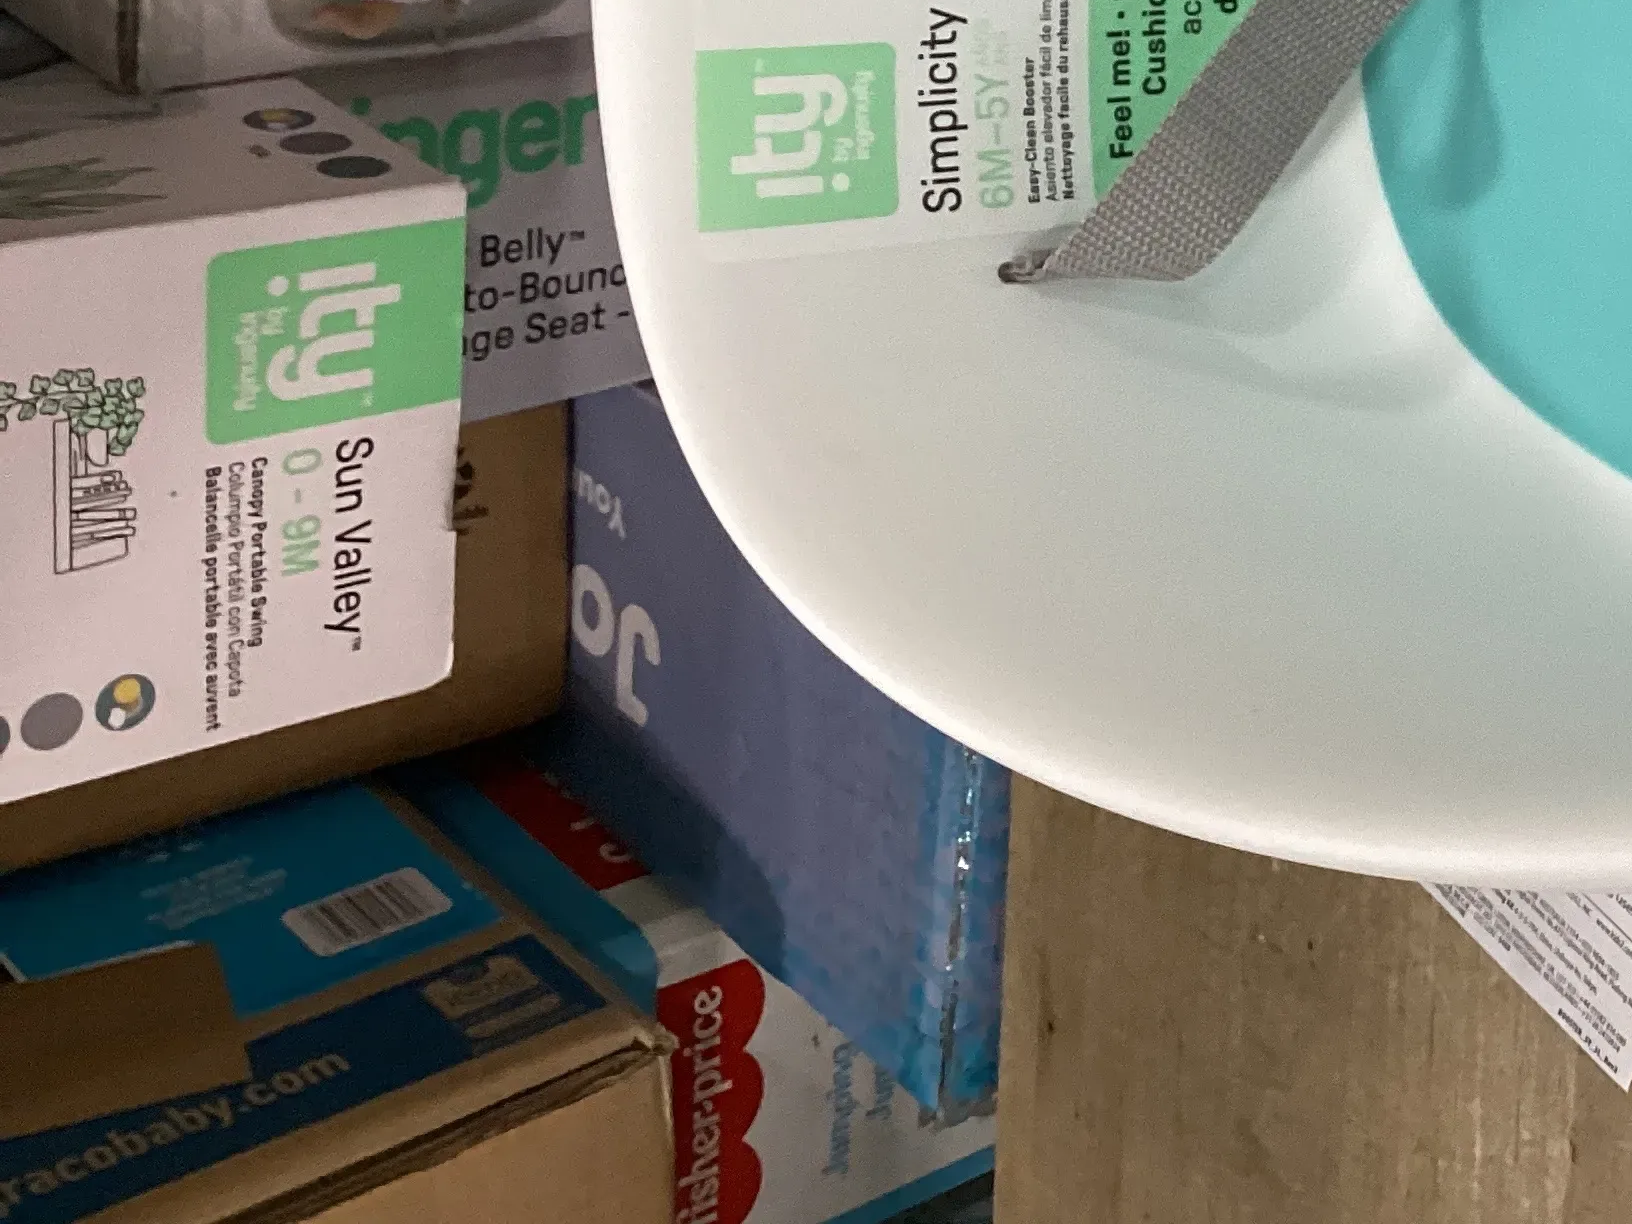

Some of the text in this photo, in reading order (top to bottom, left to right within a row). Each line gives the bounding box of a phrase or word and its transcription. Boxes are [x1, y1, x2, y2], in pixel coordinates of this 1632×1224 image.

[1040, 25, 1053, 43] de
[1057, 55, 1069, 74] du
[1106, 28, 1131, 86] me!
[917, 7, 968, 213] Simplicity
[1041, 80, 1055, 143] elevador
[1057, 77, 1070, 119] facile
[1107, 94, 1134, 158] Feel
[1022, 57, 1041, 204] Easy-Clean Booster
[1059, 123, 1075, 200] Nettoyage
[1043, 146, 1059, 201] Asiento
[524, 302, 606, 344] Seat
[335, 437, 375, 514] Sun
[247, 456, 268, 647] Canopy Portable Swing
[280, 515, 322, 577] 9M
[201, 465, 222, 732] Balancelle portable avec auvent
[224, 461, 246, 697] Columpio Portátil con Capota
